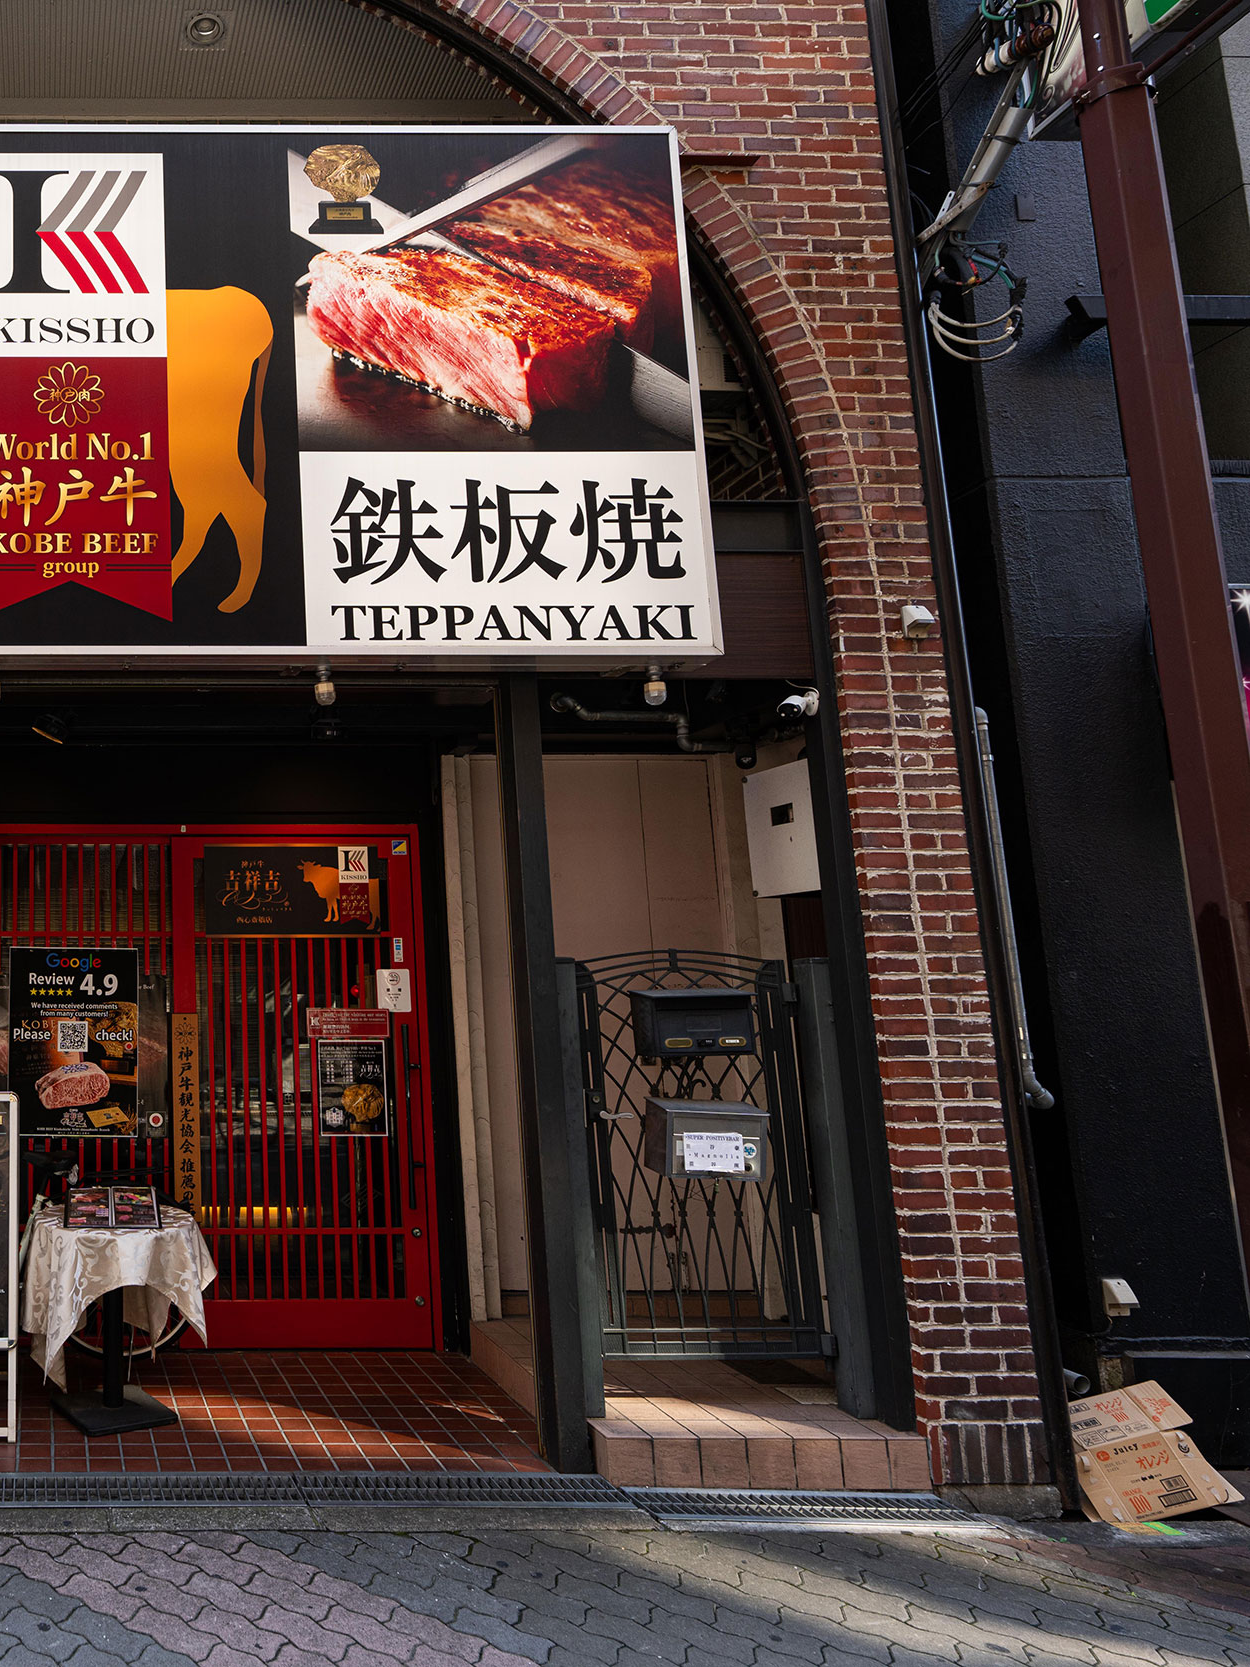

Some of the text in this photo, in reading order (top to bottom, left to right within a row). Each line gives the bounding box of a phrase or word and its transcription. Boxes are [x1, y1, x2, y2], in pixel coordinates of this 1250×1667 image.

[49, 388, 90, 403] 神戸肉
[86, 432, 154, 460] No.1
[330, 477, 687, 585] 鉄板焼
[82, 532, 159, 554] BEEF
[43, 560, 100, 578] group
[331, 605, 698, 640] TEPPANYAKI
[224, 870, 281, 891] 吉祥吉
[46, 953, 101, 972] Google
[29, 973, 118, 995] Review 4.9
[13, 1028, 133, 1041] Please check!
[1094, 1397, 1122, 1411] オレンジ
[1113, 1443, 1139, 1455] Juicy
[1135, 1449, 1169, 1470] オレンジ
[1129, 1494, 1152, 1514] 100
